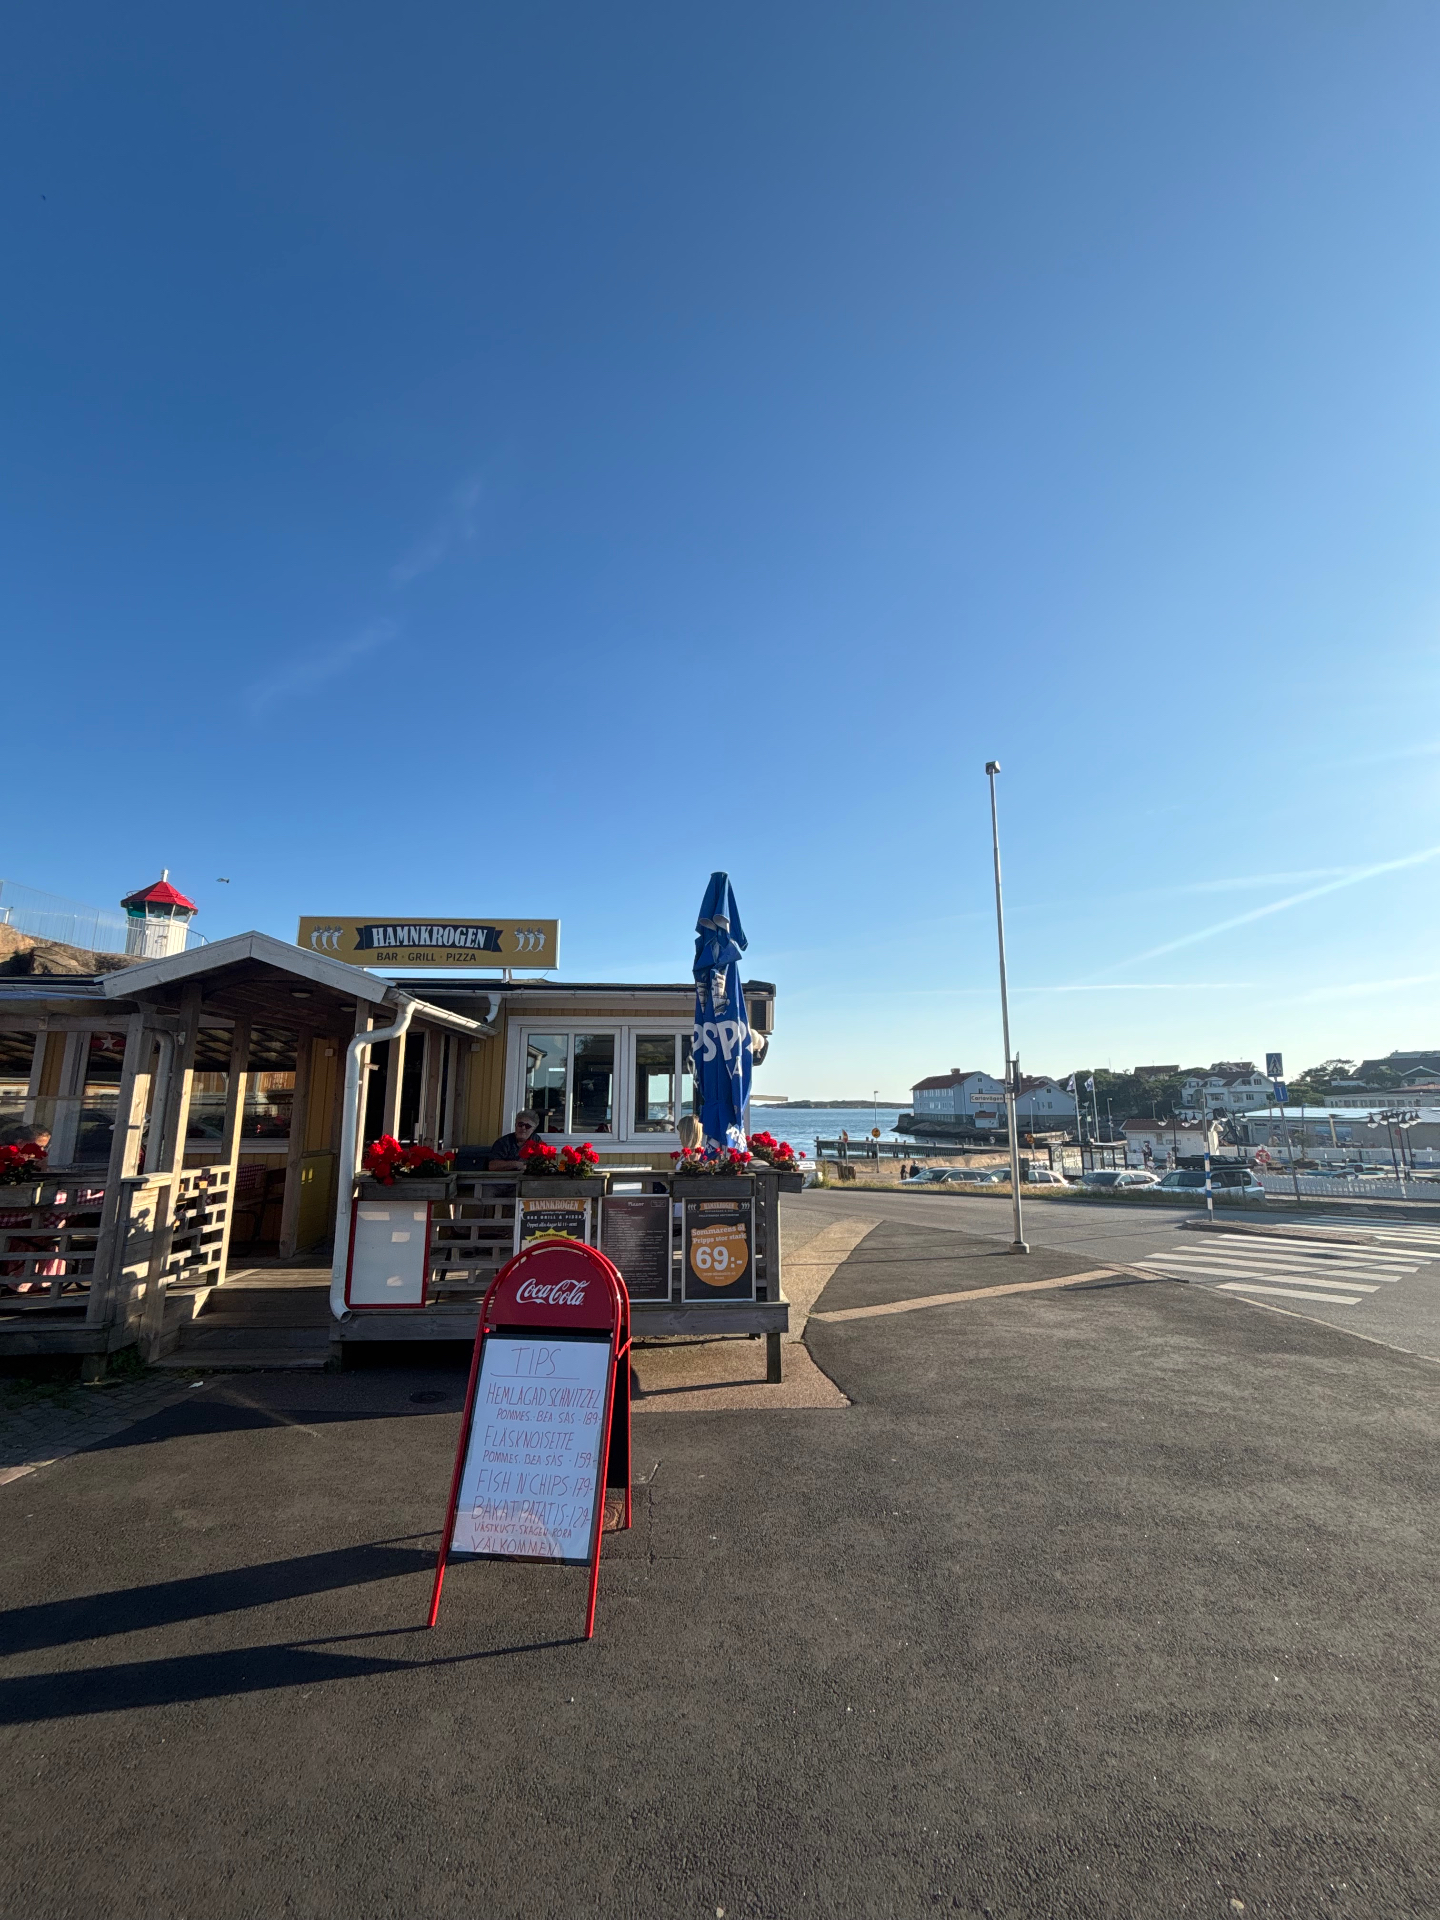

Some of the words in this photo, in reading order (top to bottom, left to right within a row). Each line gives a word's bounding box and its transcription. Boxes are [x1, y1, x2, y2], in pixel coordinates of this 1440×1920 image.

[371, 925, 488, 949] HAMNKROGEN
[376, 952, 398, 961] BAR
[407, 952, 437, 962] GRILL
[446, 952, 477, 962] PIZZA
[529, 1200, 580, 1211] HAMNKROGEN
[692, 1225, 737, 1236] Sommarens
[692, 1236, 715, 1245] Pripps
[715, 1234, 728, 1242] stor
[729, 1232, 747, 1241] stark
[695, 1246, 743, 1271] 69:-
[516, 1278, 591, 1306] Coca-Cola
[511, 1347, 562, 1376] TIPS
[485, 1382, 547, 1407] HEMLAGAD
[547, 1386, 602, 1409] SCHNITZEL
[483, 1424, 574, 1451] FLÄSKNOISETTE
[476, 1468, 512, 1494] FISH
[471, 1535, 558, 1556] VÄLKOMMEN
